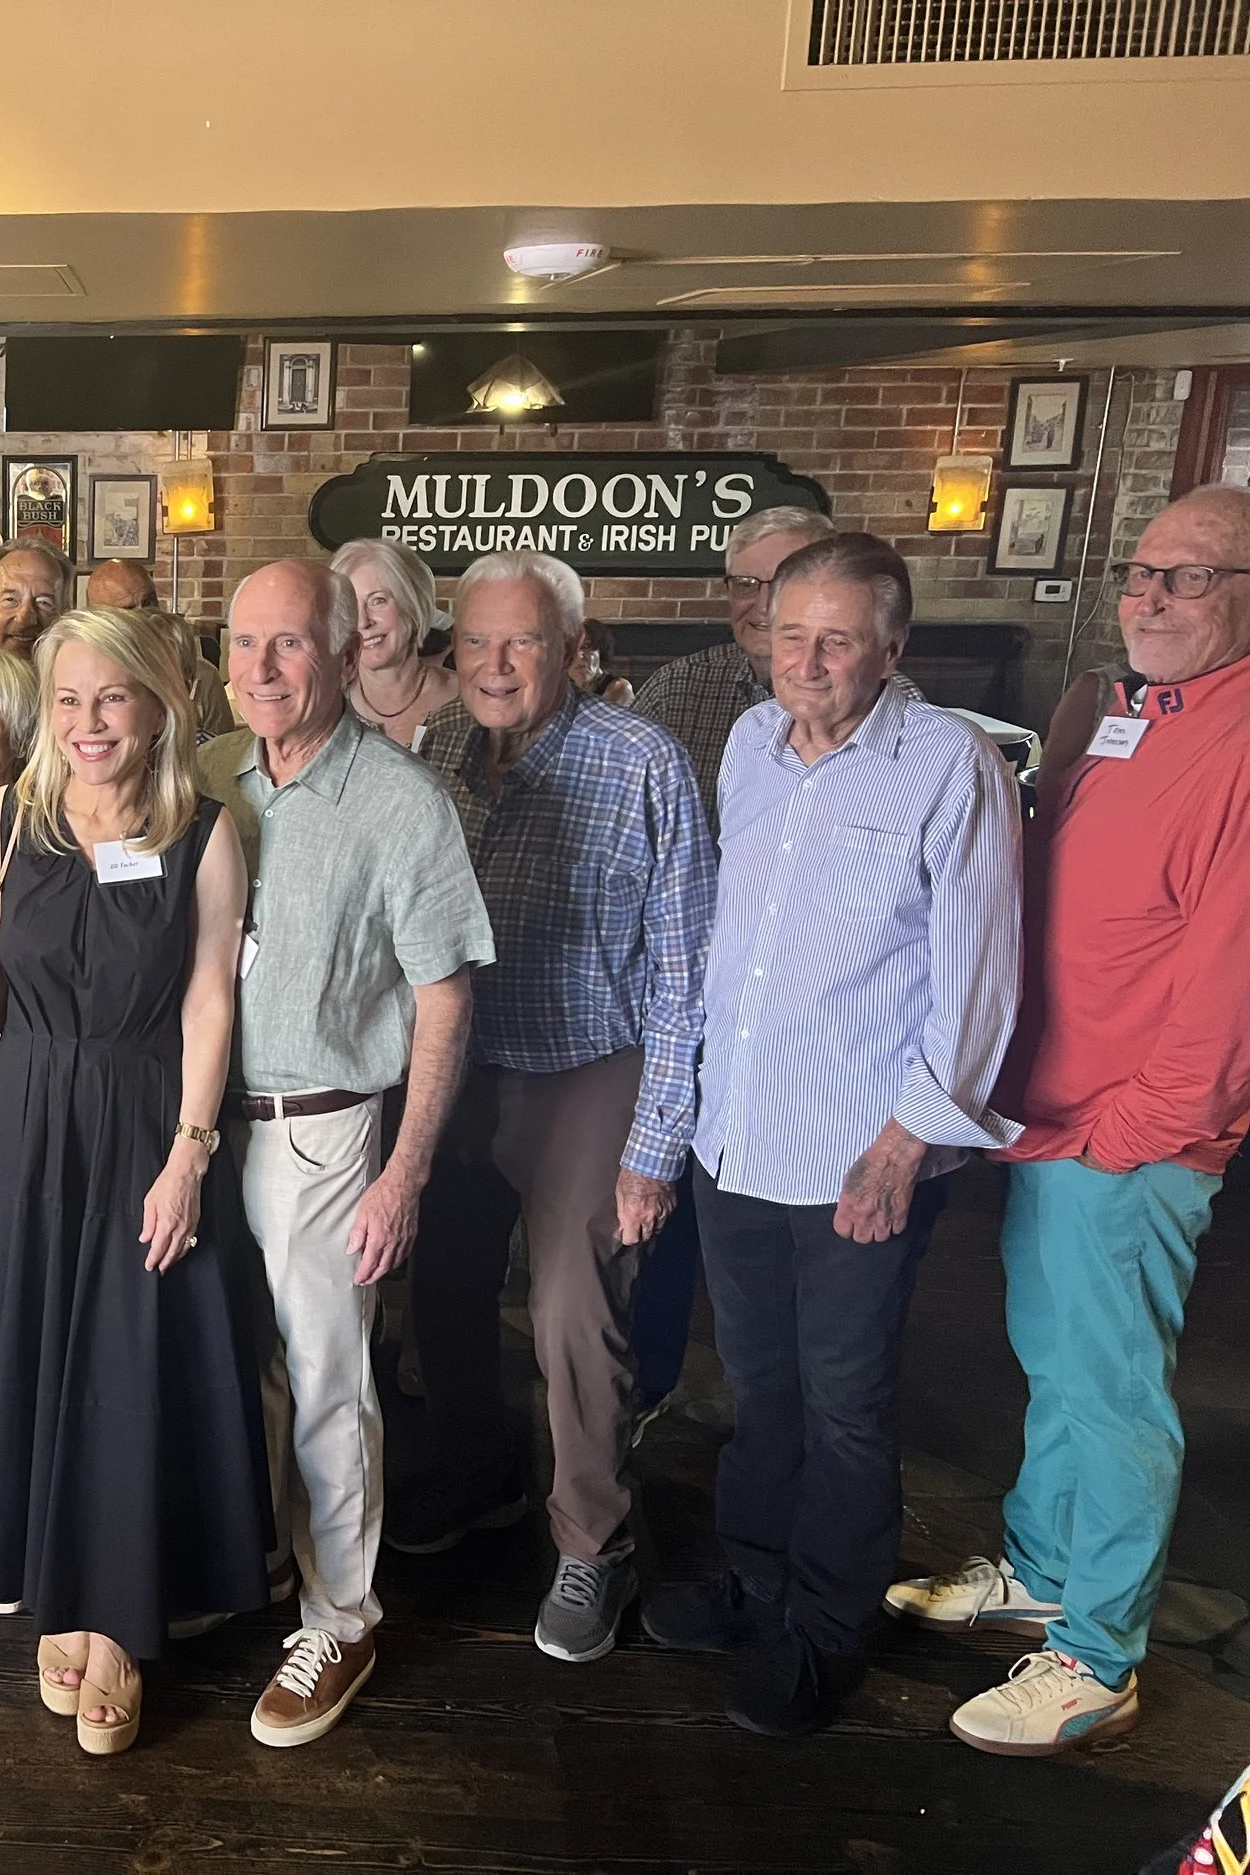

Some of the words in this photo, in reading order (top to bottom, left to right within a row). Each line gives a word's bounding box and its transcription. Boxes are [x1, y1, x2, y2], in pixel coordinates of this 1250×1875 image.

[576, 248, 604, 259] FIRE
[381, 470, 754, 518] MULDOON'S
[19, 501, 62, 511] BLACK
[22, 511, 58, 520] BUSH
[578, 533, 594, 552] &
[601, 525, 676, 552] IRISH
[690, 525, 738, 552] PU
[1157, 688, 1184, 715] FJ
